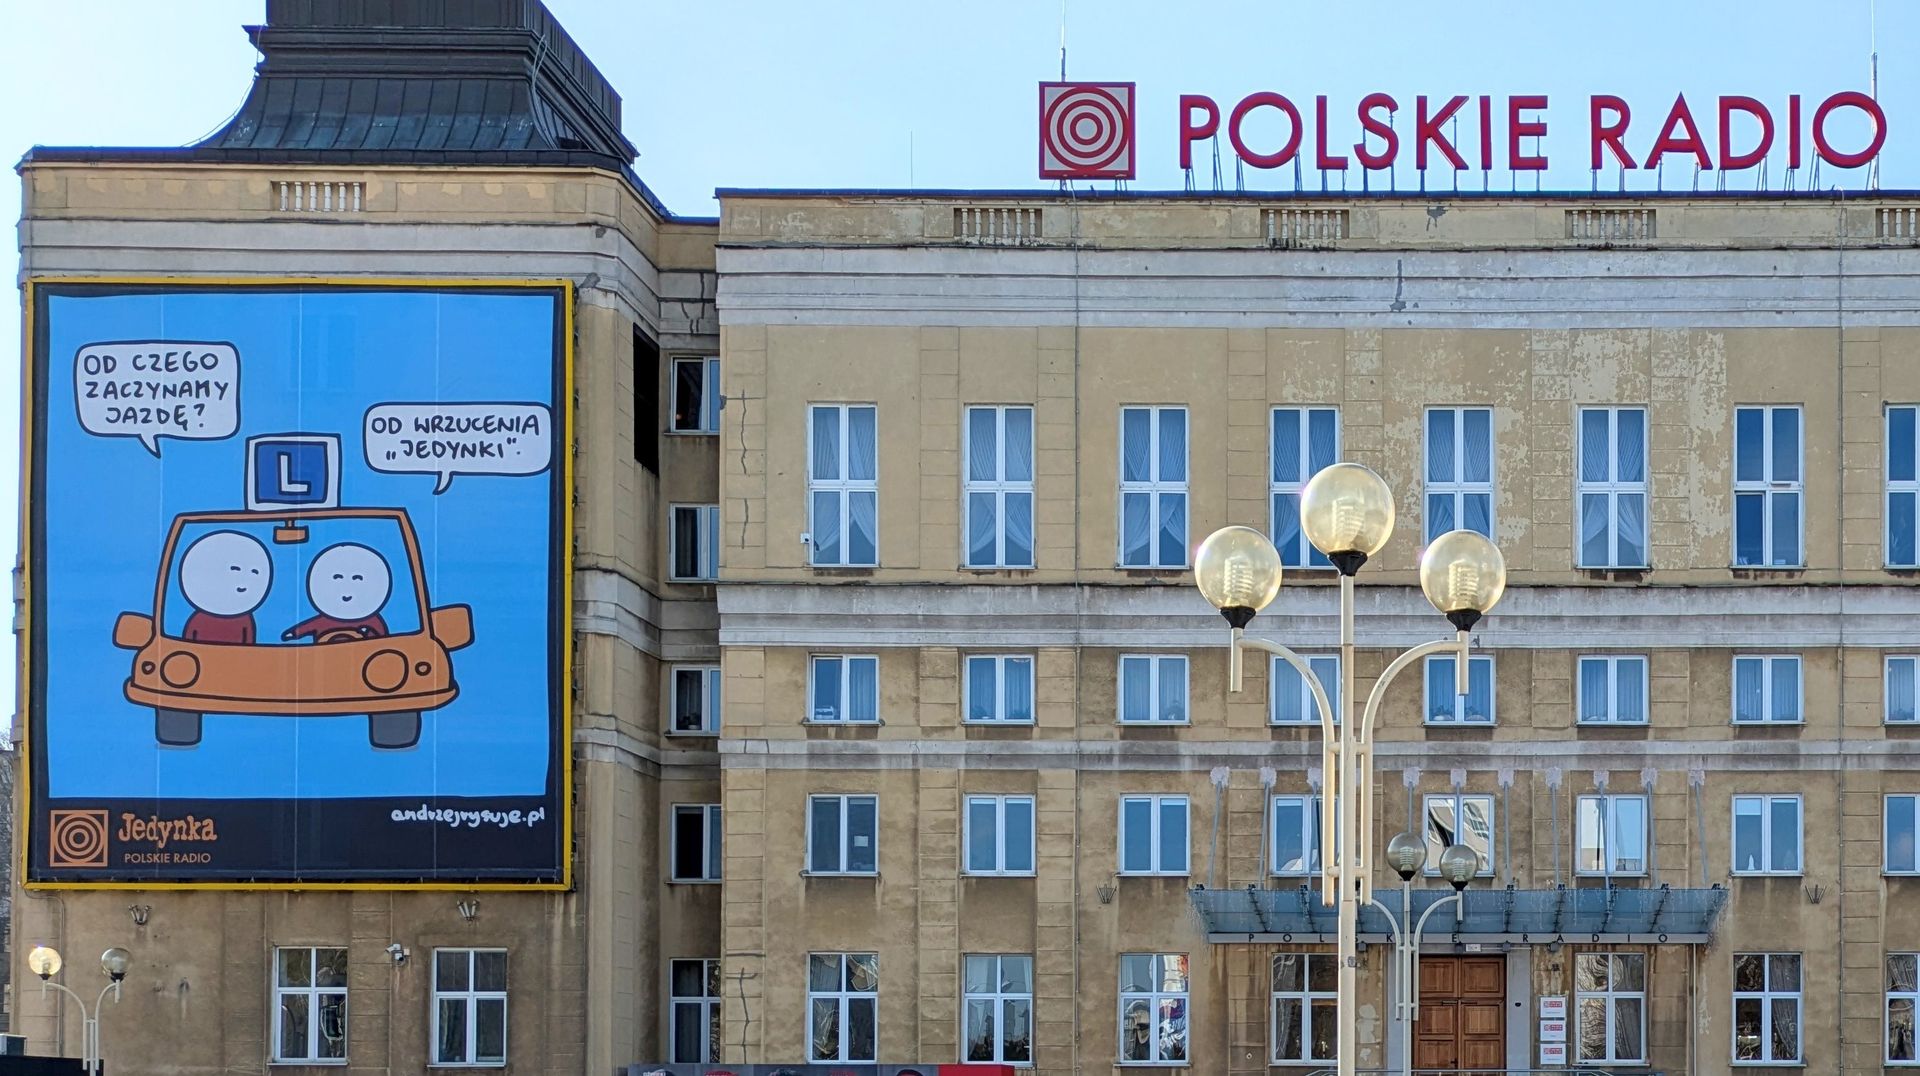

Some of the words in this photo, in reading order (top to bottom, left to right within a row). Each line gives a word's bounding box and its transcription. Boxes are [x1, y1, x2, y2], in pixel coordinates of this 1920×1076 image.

[1179, 91, 1549, 171] POLSKIE
[1590, 91, 1887, 171] RADIO
[84, 354, 117, 376] OD
[132, 351, 219, 373] CZEGO
[85, 380, 229, 400] ZACZYNAMY
[371, 416, 403, 434] OD
[414, 415, 540, 436] WRZUCENIA
[277, 452, 311, 495] L
[391, 804, 545, 828] andrzejrysuje.pl
[118, 812, 218, 849] Jedynka
[124, 853, 171, 863] POLSKIE
[173, 852, 212, 863] RADIO
